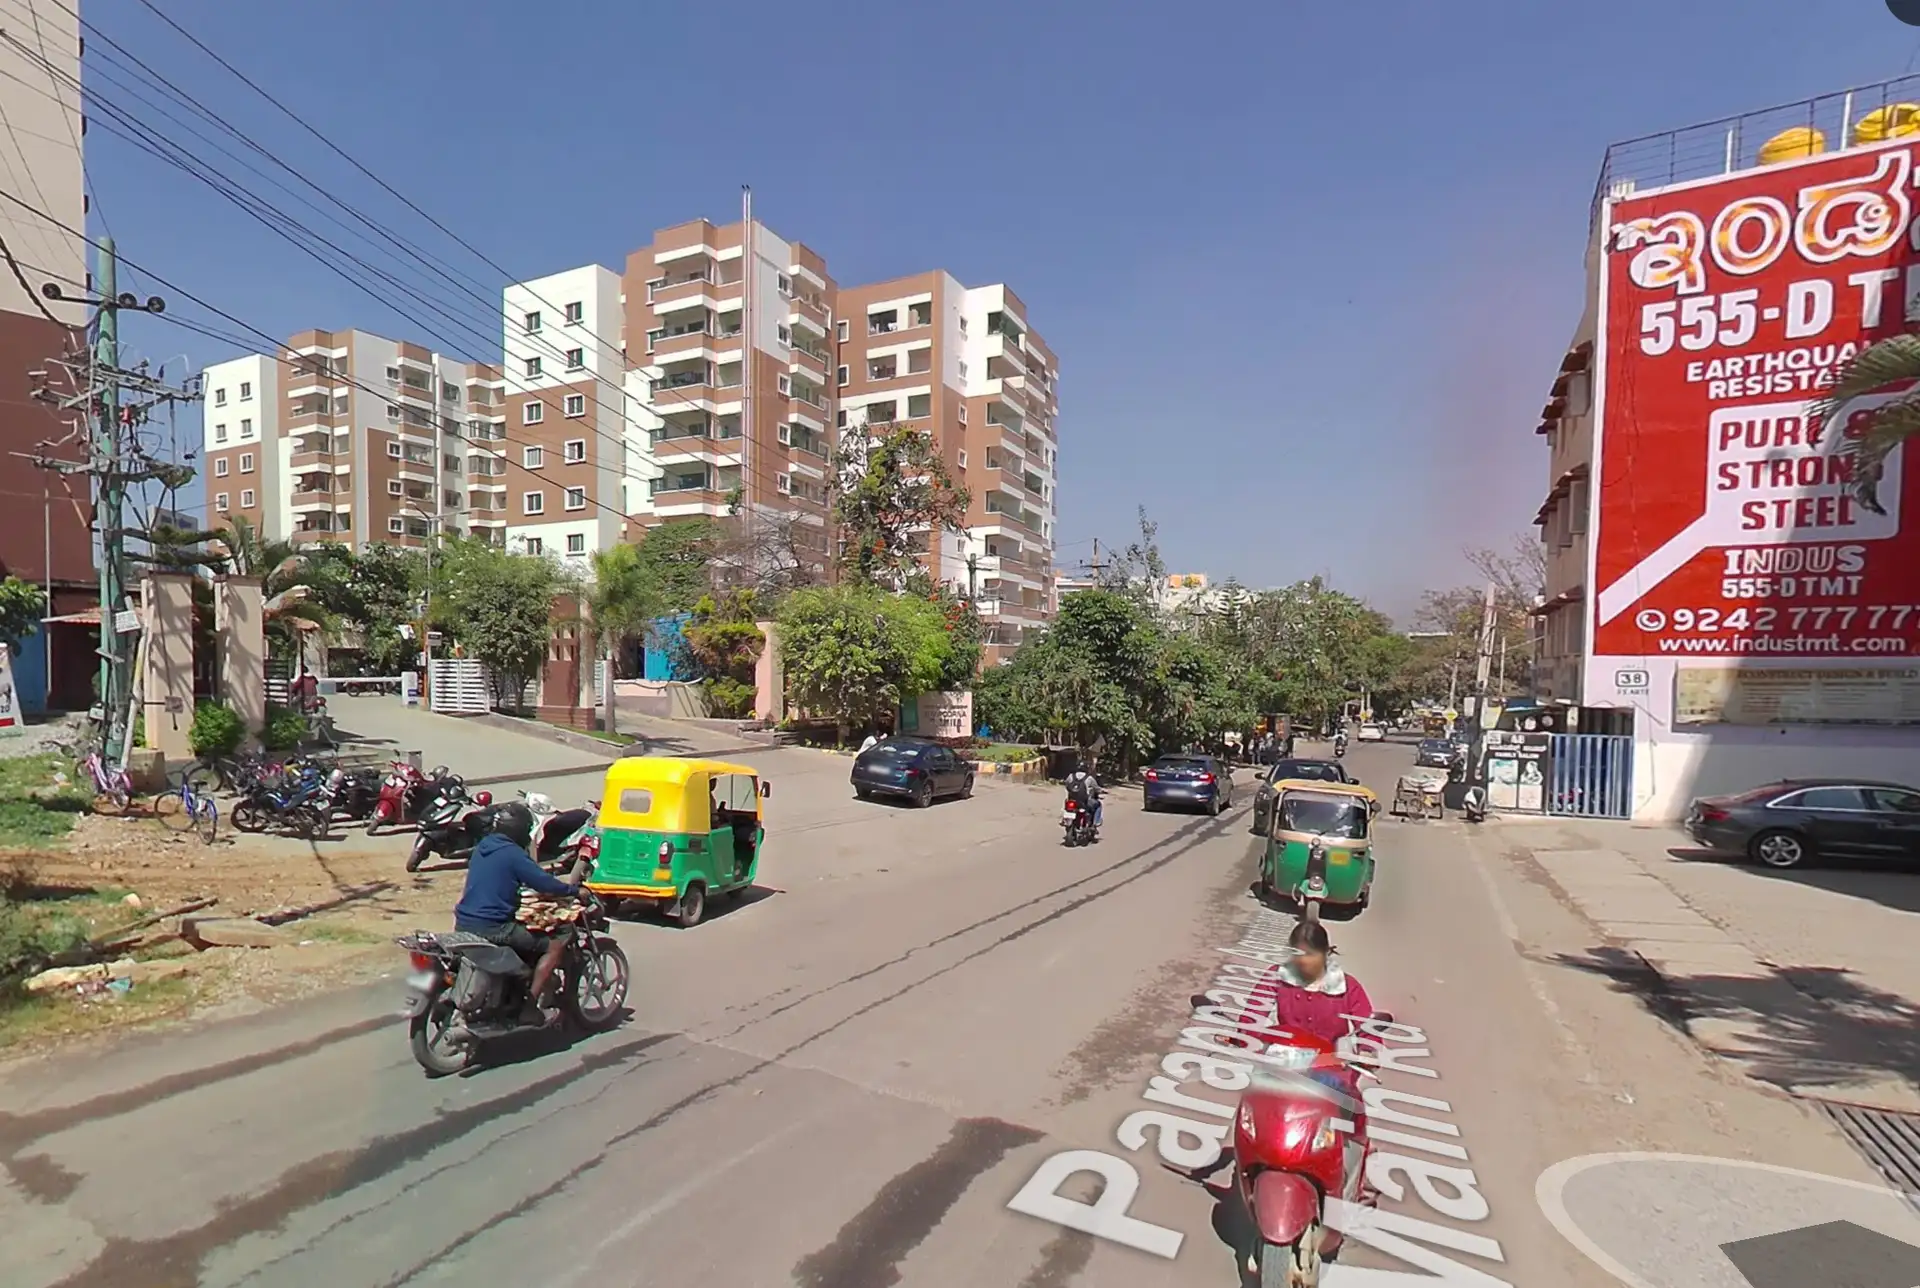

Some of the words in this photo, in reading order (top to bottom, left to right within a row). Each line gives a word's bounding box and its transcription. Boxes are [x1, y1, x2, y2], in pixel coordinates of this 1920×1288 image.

[1639, 279, 1833, 356] 555-D
[1688, 343, 1869, 382] EARTHQUA
[1708, 371, 1845, 399] RESISTA
[1717, 452, 1883, 490] STRON
[1741, 496, 1856, 530] STEEL
[1723, 546, 1867, 576] INDUS
[1721, 578, 1797, 598] 555-D
[1804, 575, 1863, 596] TMT
[1673, 608, 1775, 631] 9242
[1788, 606, 1858, 630] 777
[1659, 634, 1906, 652] www.industmt.com
[1620, 673, 1641, 684] 38
